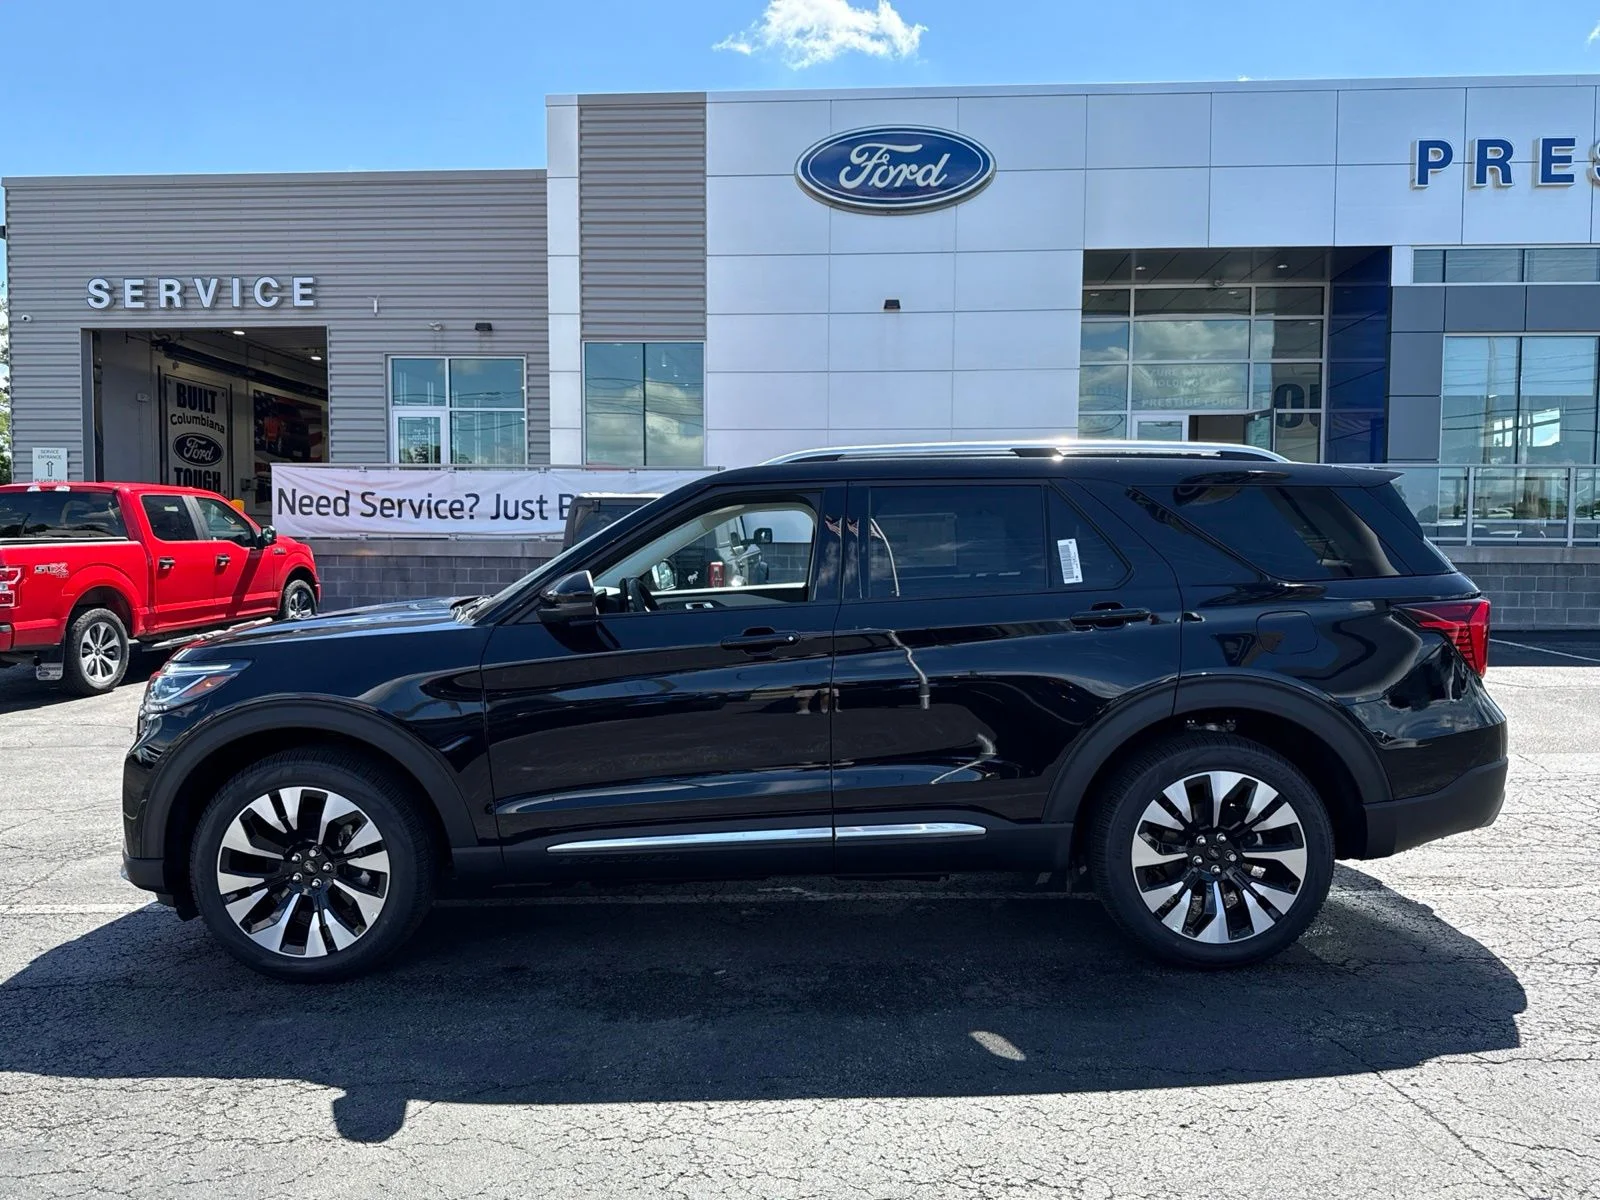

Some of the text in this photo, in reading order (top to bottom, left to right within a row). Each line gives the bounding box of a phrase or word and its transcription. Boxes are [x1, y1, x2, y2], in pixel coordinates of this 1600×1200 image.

[838, 142, 951, 190] Ford
[1413, 136, 1600, 189] PRE
[86, 276, 318, 310] SERVICE
[176, 382, 217, 414] BUILT
[170, 411, 225, 434] Columbiana
[183, 437, 214, 462] Ford
[174, 467, 221, 493] TOUGH
[277, 487, 350, 517] Need
[360, 491, 480, 521] Service?
[490, 493, 549, 521] Just
